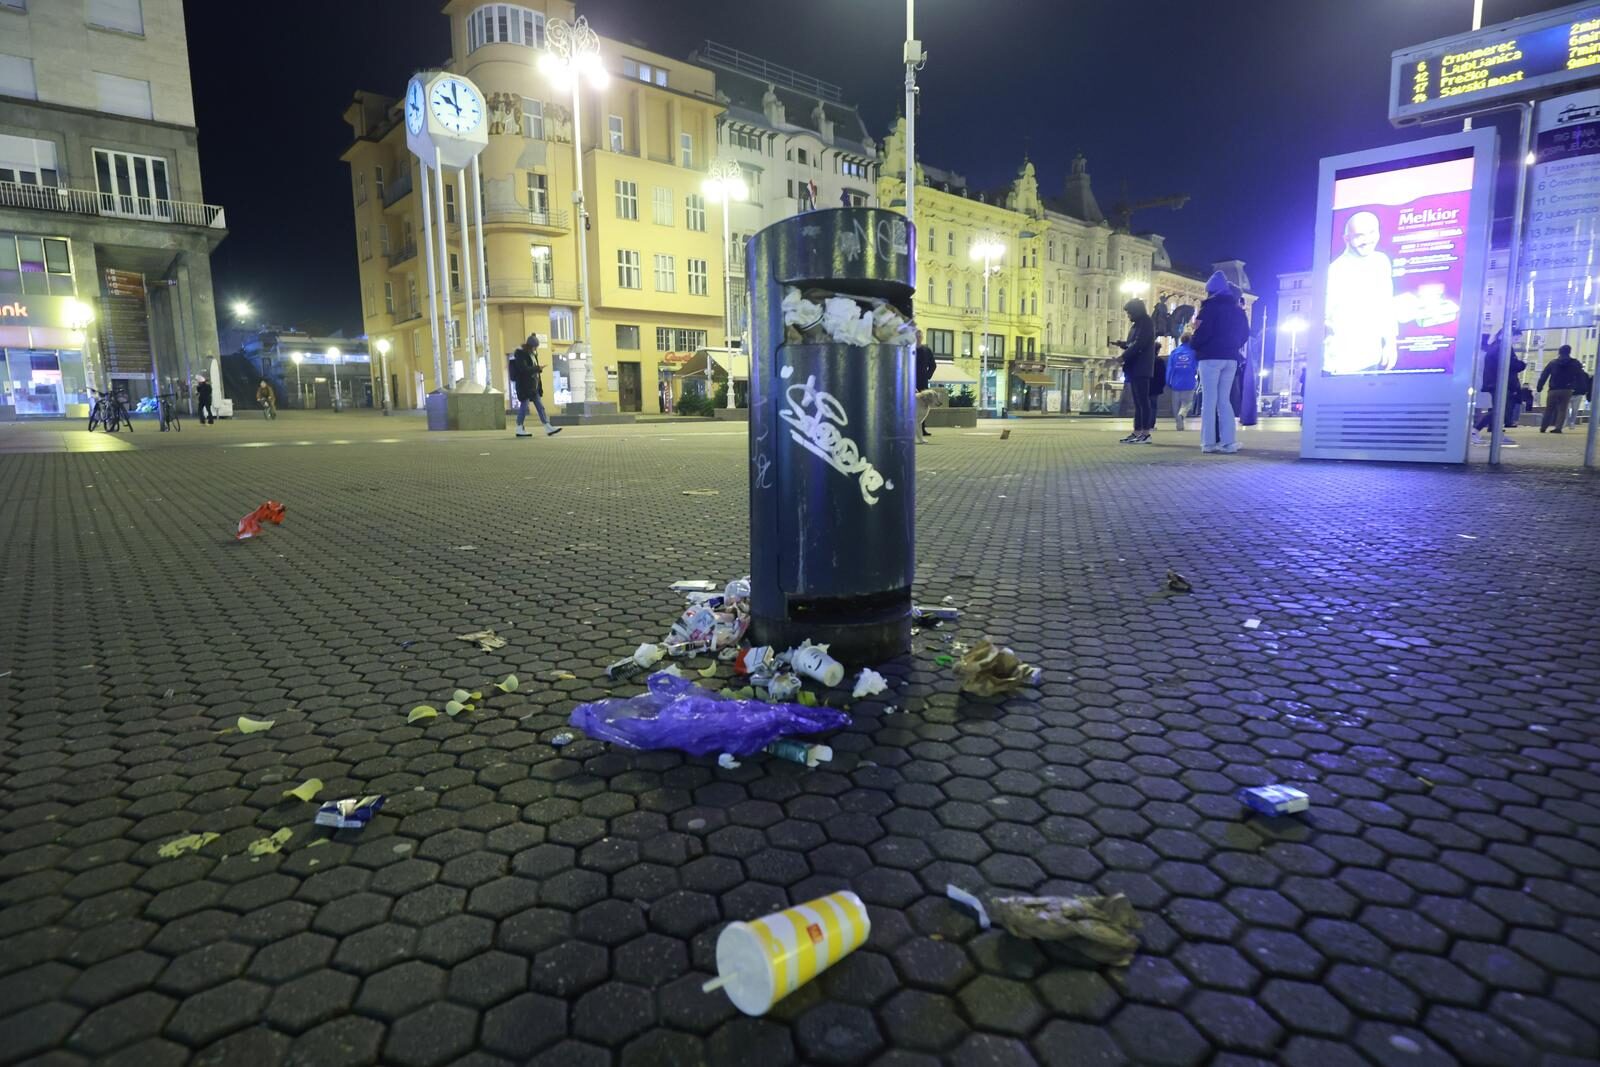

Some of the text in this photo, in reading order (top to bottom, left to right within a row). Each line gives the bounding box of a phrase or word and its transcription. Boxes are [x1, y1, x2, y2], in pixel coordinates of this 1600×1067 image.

[1417, 61, 1427, 72] 6
[1413, 71, 1429, 83] 12
[1488, 70, 1524, 88] most
[1413, 82, 1429, 93] 17
[1538, 181, 1546, 191] 6
[1399, 208, 1460, 226] Melkior
[0, 302, 28, 317] nk
